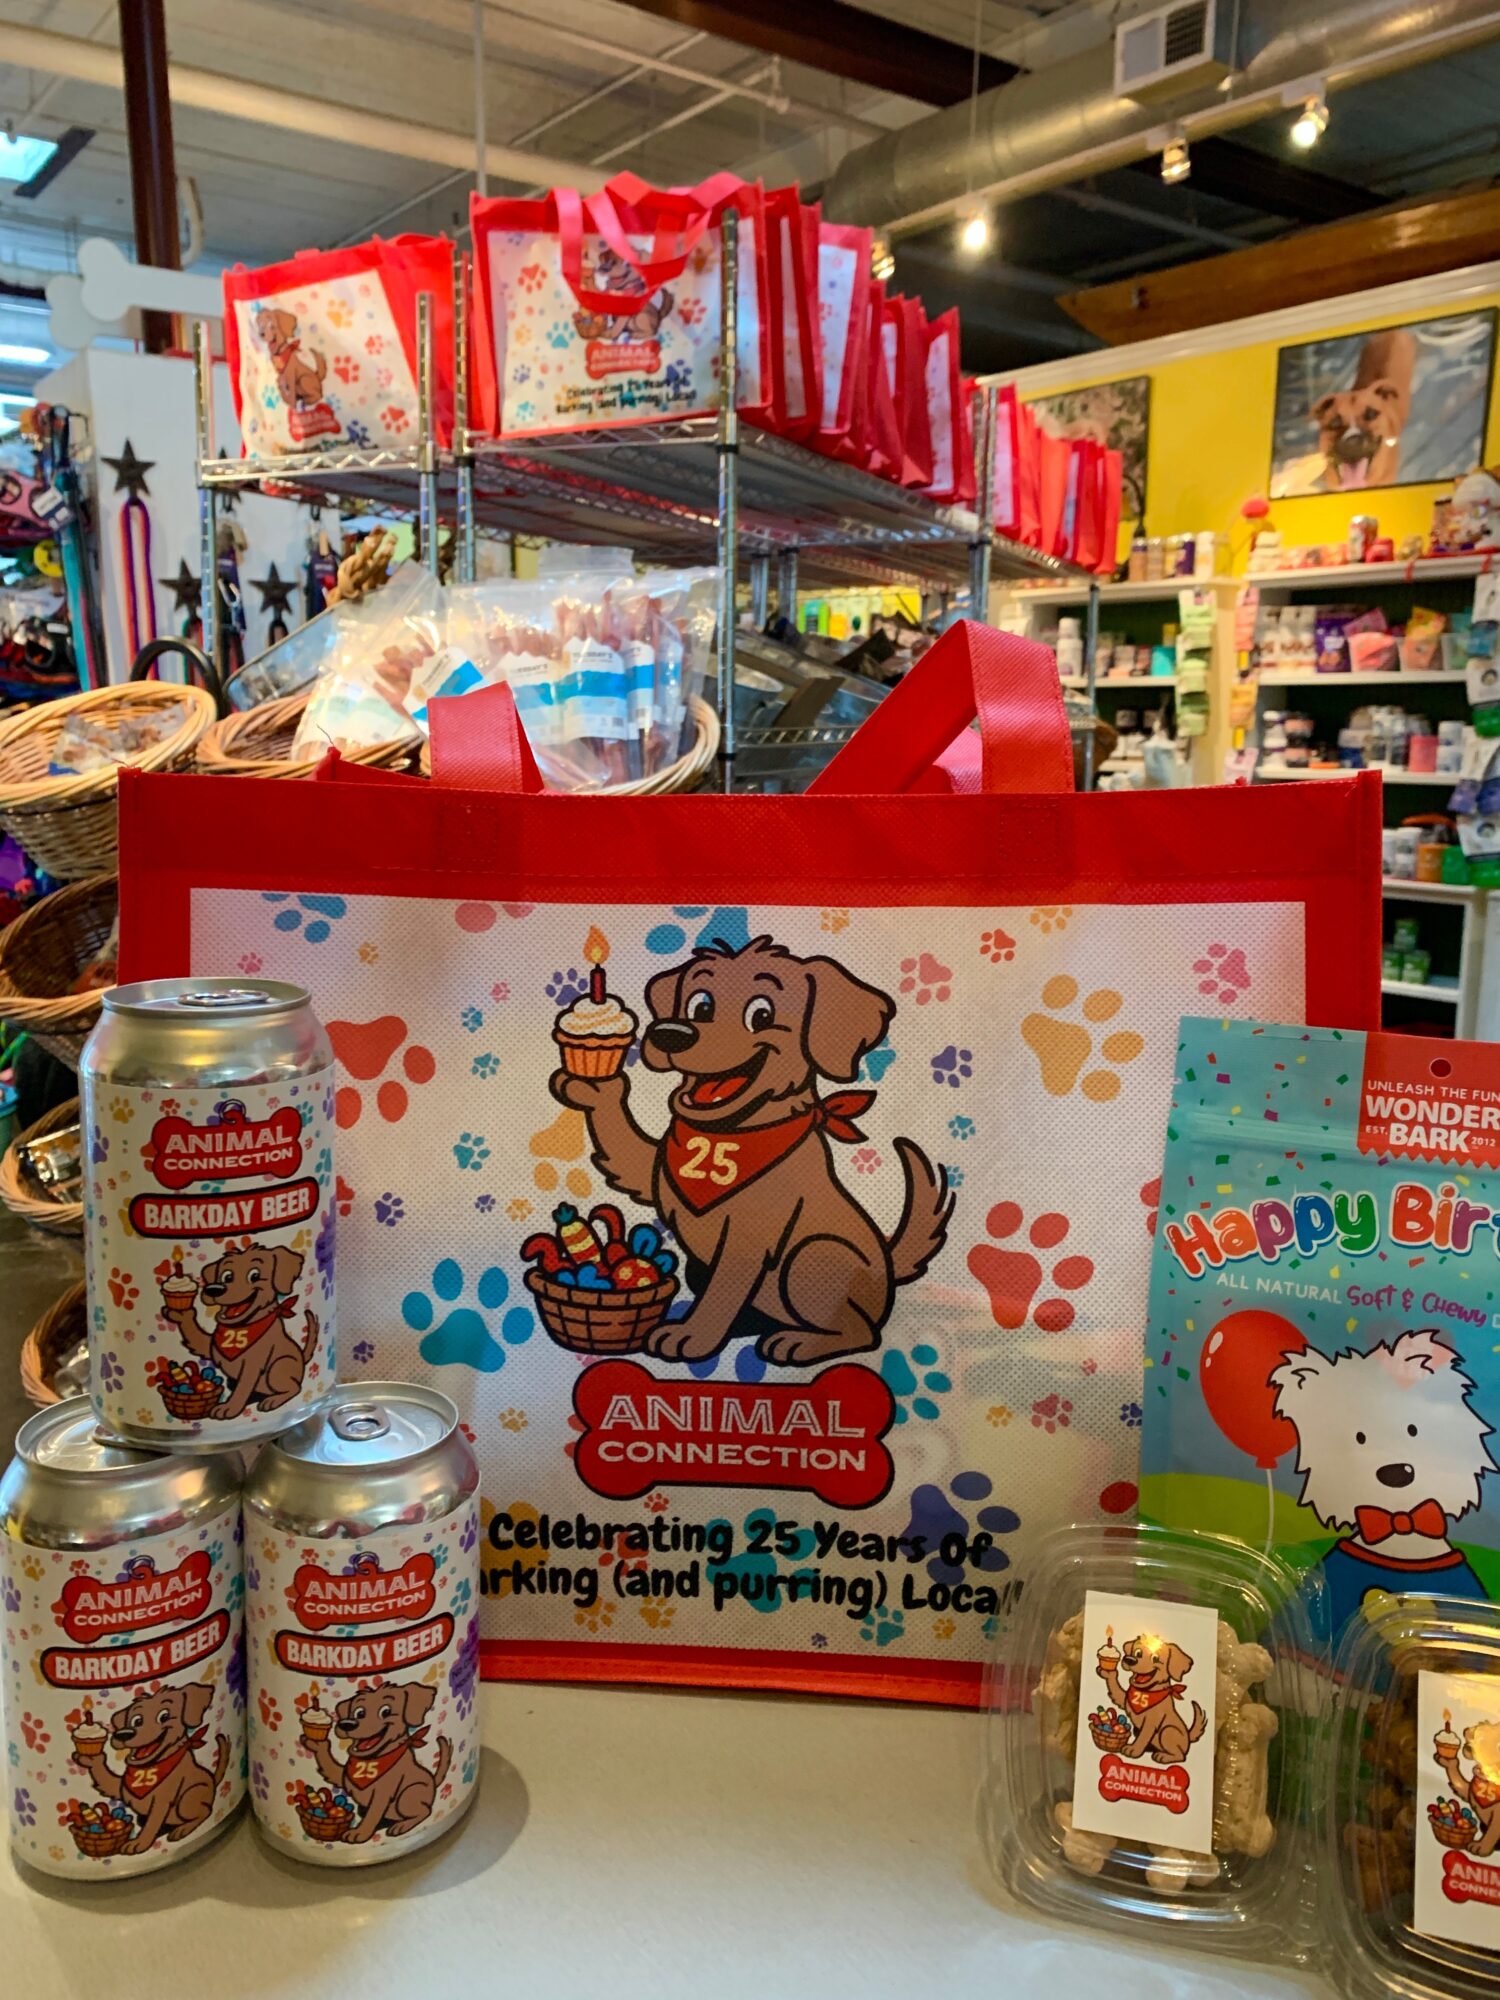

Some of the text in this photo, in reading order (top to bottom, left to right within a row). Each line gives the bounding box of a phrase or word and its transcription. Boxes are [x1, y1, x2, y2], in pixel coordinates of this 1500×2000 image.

[1367, 1080, 1500, 1103] UNLEASH THE FUN
[1365, 1094, 1500, 1131] WONDER
[164, 1124, 293, 1155] ANIMAL
[1389, 1122, 1471, 1153] BARK
[1471, 1136, 1496, 1148] 2012
[163, 1146, 293, 1171] CONNECTION
[678, 1137, 741, 1186] 25
[144, 1188, 310, 1230] BARKDAY BEER
[1164, 1192, 1379, 1278] Happy
[1216, 1271, 1249, 1290] ALL
[1255, 1277, 1343, 1305] NATURAL
[1346, 1284, 1398, 1312] Soft
[1401, 1287, 1415, 1313] &
[220, 1329, 249, 1351] 25
[600, 1394, 866, 1438] ANIMAL
[597, 1441, 866, 1472] CONNECTION
[488, 1512, 993, 1568] Celebrating 25 Years Of
[73, 1571, 202, 1611] ANIMAL
[305, 1572, 427, 1600] ANIMAL
[613, 1561, 699, 1599] (and
[713, 1571, 888, 1620] purring)
[73, 1589, 203, 1627] CONNECTION
[303, 1589, 426, 1616] CONNECTION
[55, 1620, 221, 1681] BARKDAY BEER
[286, 1623, 444, 1669] BARKDAY BEER
[1131, 1690, 1150, 1708] 25
[131, 1766, 159, 1789] 25
[353, 1760, 379, 1779] 25
[1106, 1765, 1182, 1790] ANIMAL
[1104, 1780, 1182, 1801] CONNECTION
[1476, 1781, 1496, 1802] 25
